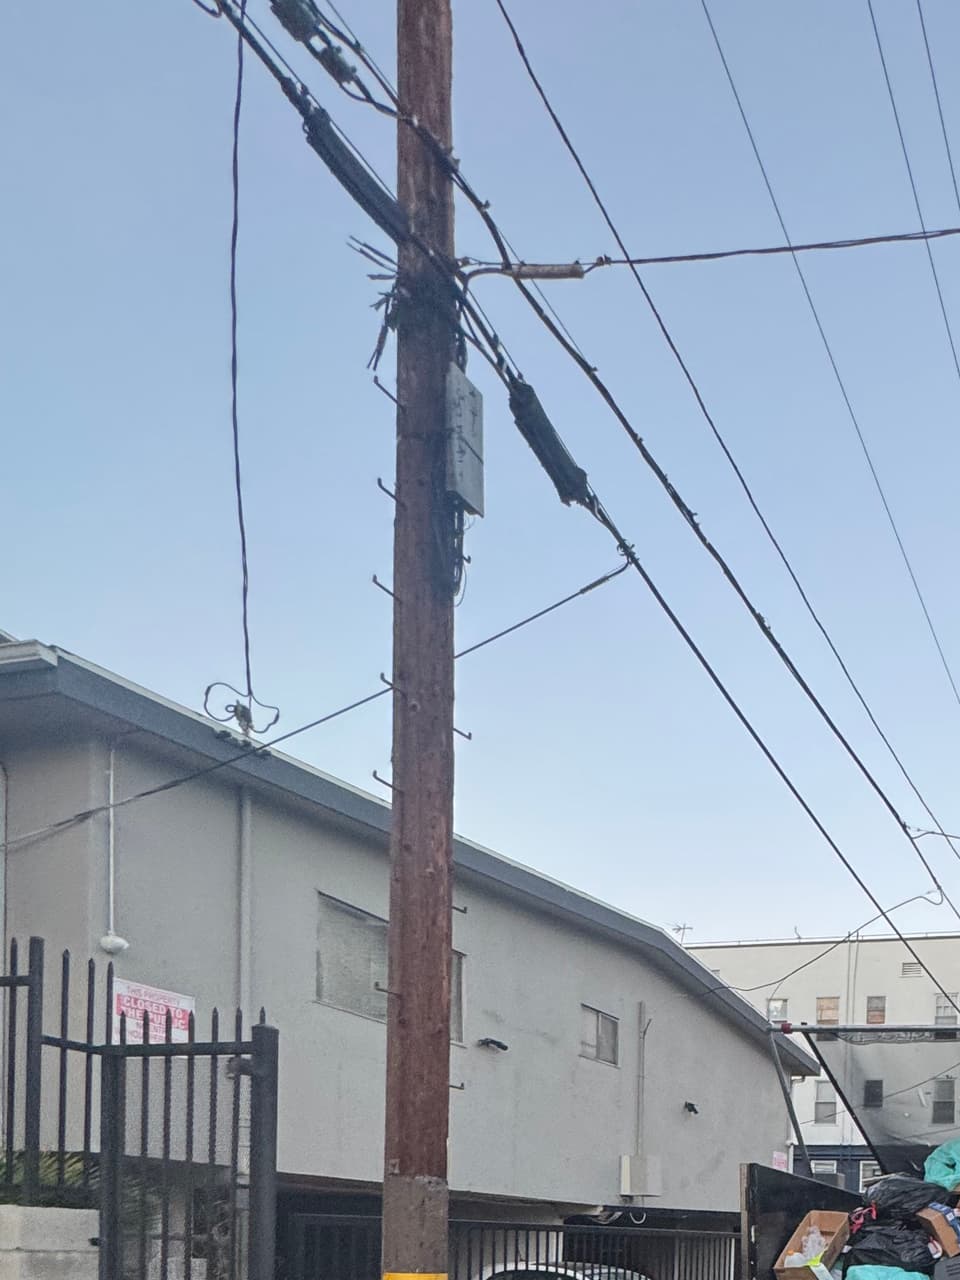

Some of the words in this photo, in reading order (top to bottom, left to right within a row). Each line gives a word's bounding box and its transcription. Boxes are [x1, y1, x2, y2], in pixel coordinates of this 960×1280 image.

[121, 1006, 143, 1020] THE
[149, 1012, 185, 1029] PUBIC
[123, 997, 167, 1014] CLOSED
[170, 1008, 183, 1019] TO
